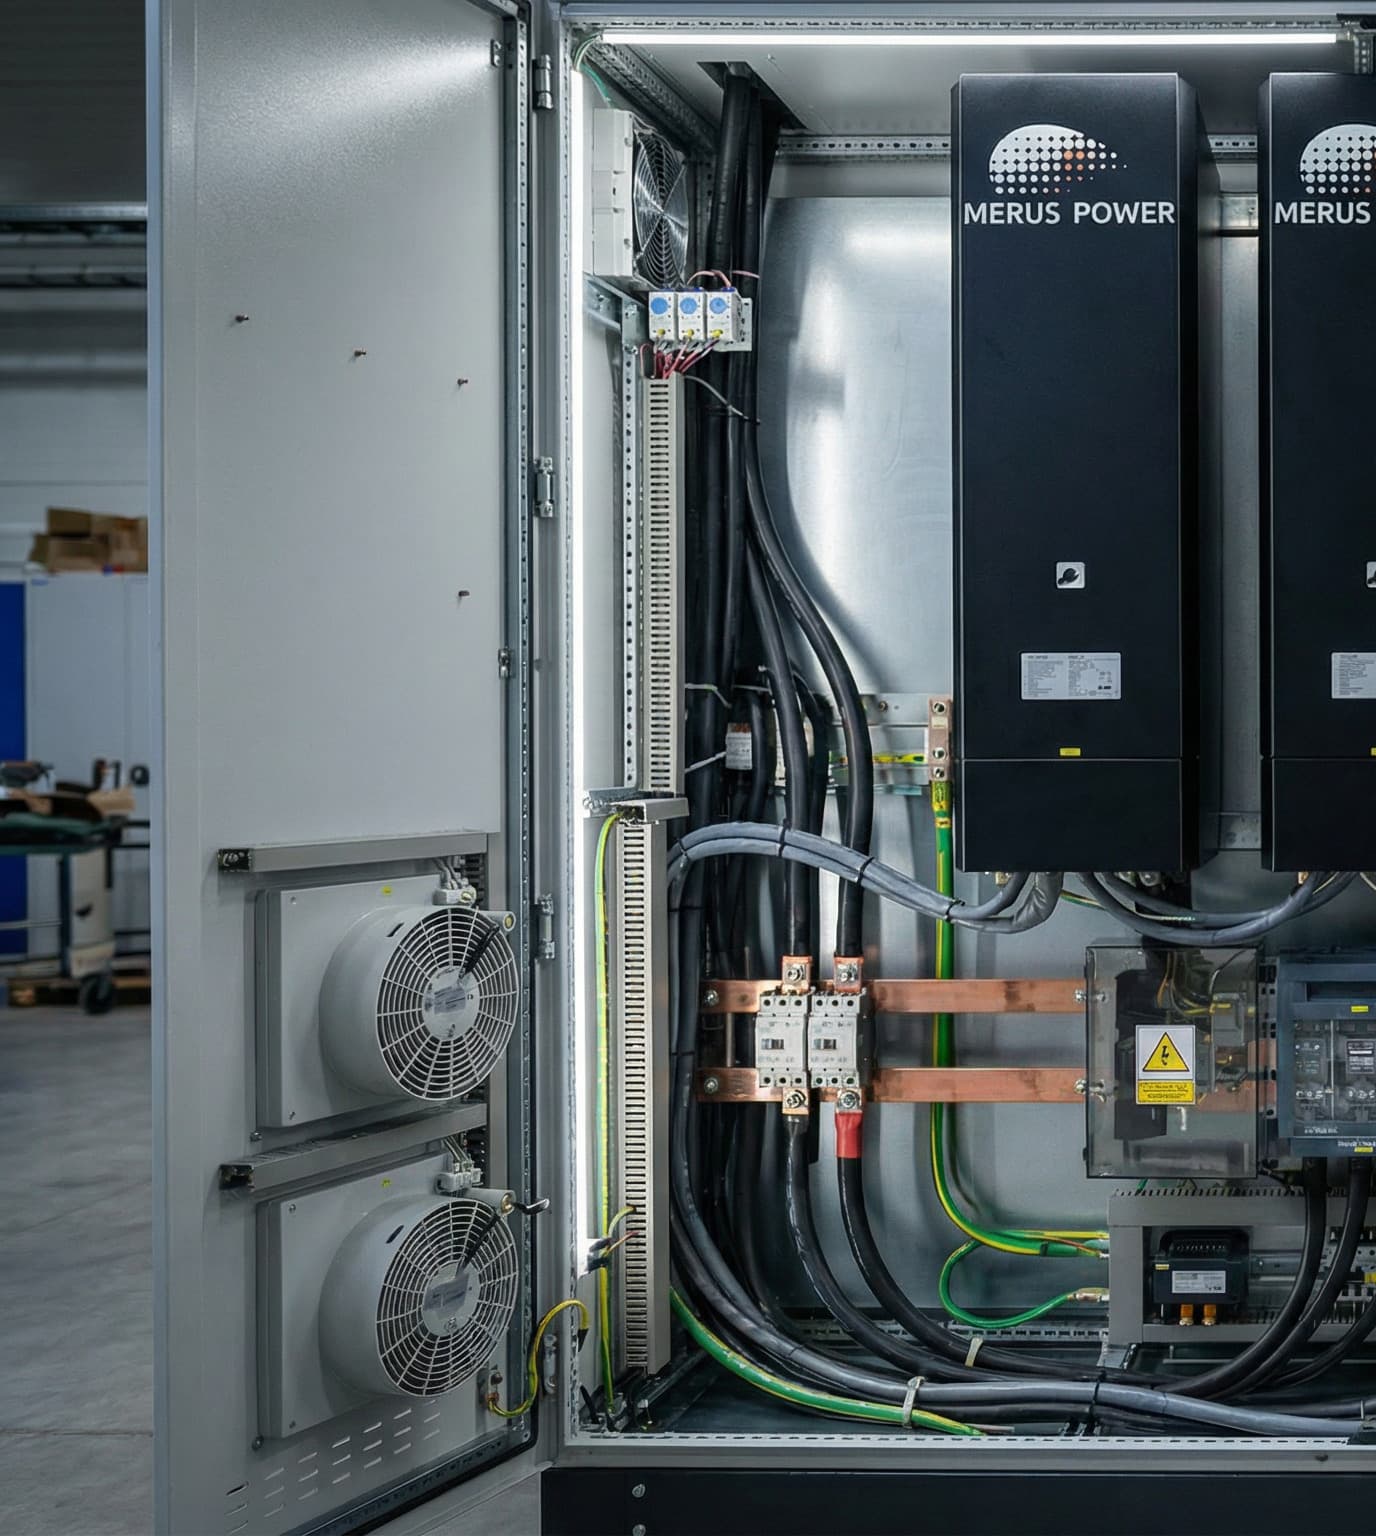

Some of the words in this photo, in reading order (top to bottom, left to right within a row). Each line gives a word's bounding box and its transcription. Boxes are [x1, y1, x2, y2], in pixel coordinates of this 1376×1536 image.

[963, 202, 1061, 224] MERUS
[1074, 201, 1176, 224] POWER
[1274, 202, 1371, 224] MERUS
